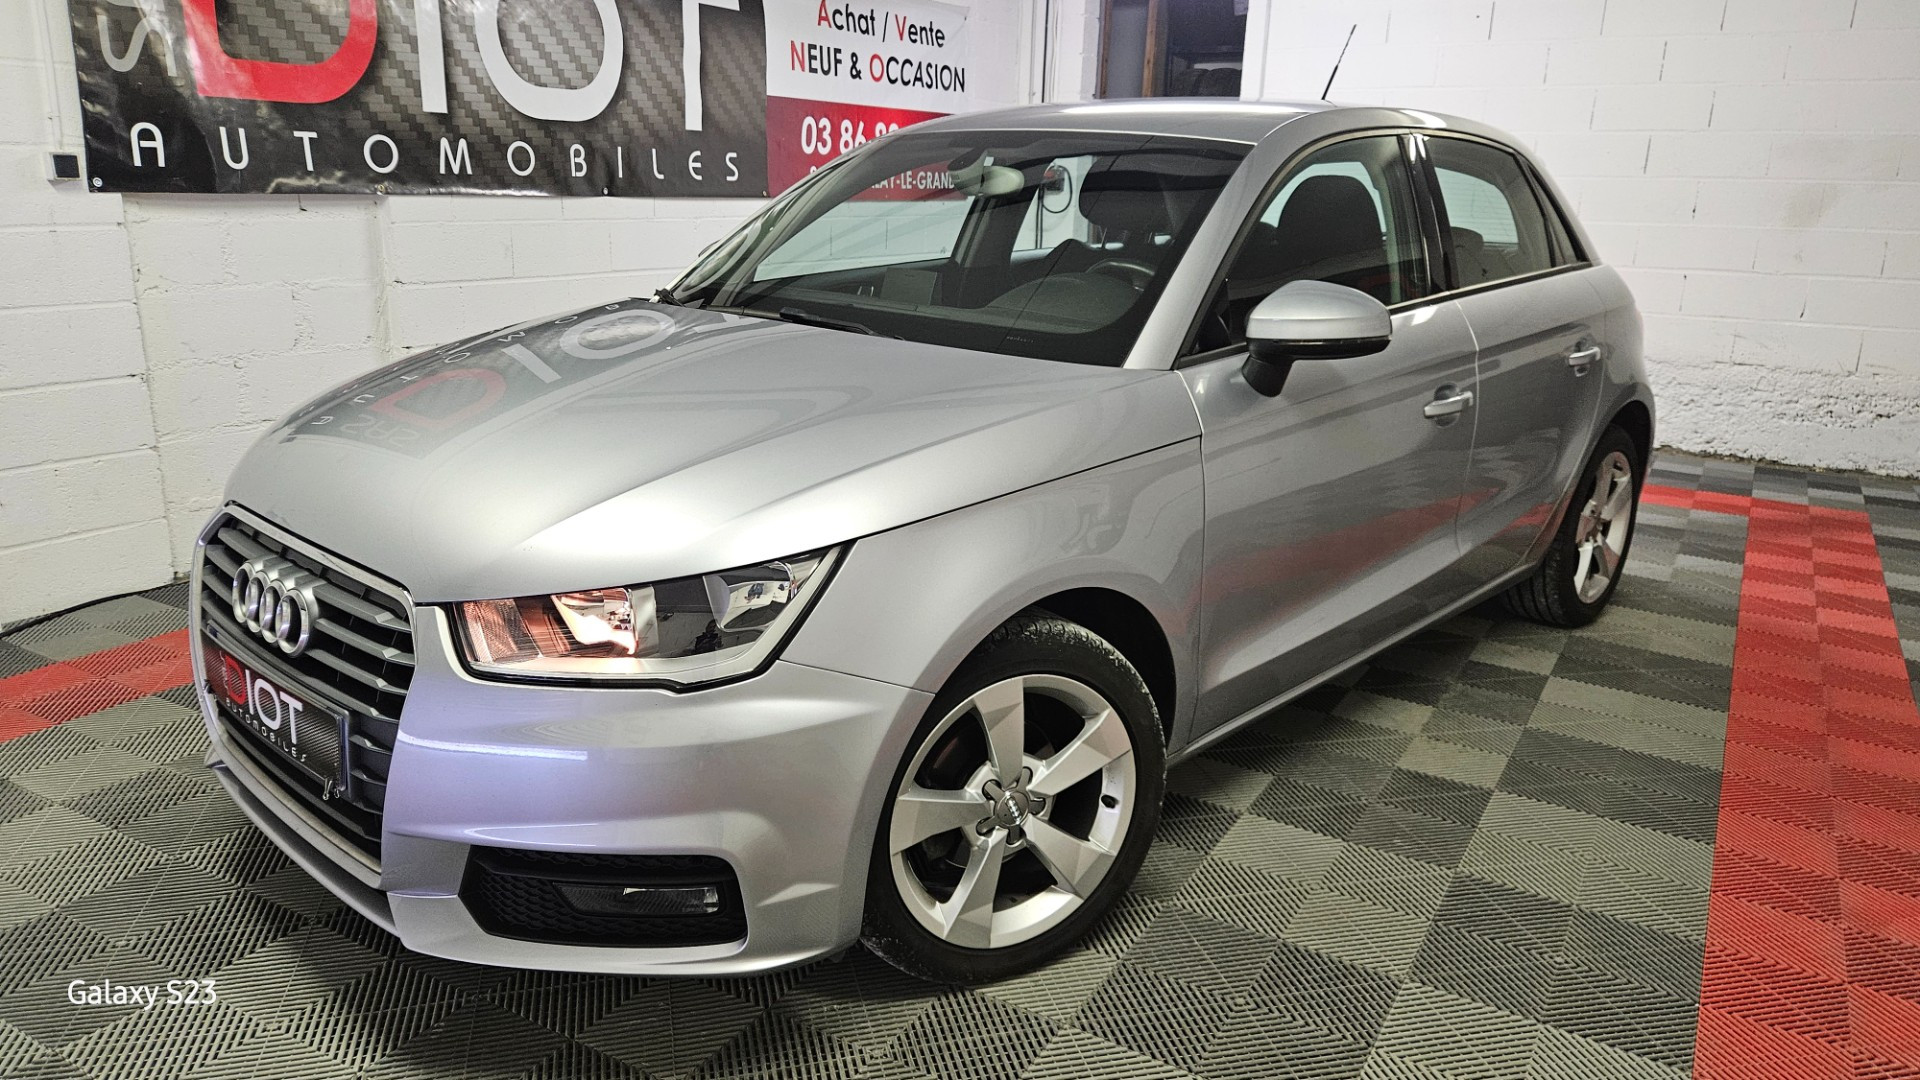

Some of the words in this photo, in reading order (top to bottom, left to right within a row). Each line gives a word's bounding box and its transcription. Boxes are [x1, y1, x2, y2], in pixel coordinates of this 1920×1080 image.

[817, 0, 876, 37] Achat
[895, 14, 945, 48] Vente
[790, 40, 843, 77] NEUF
[850, 52, 862, 80] &
[870, 53, 965, 93] OCCASION
[130, 122, 739, 182] AUTOMOBILES
[801, 116, 832, 155] 03
[225, 655, 303, 745] DIOT
[225, 697, 307, 762] AUTOMOBILES
